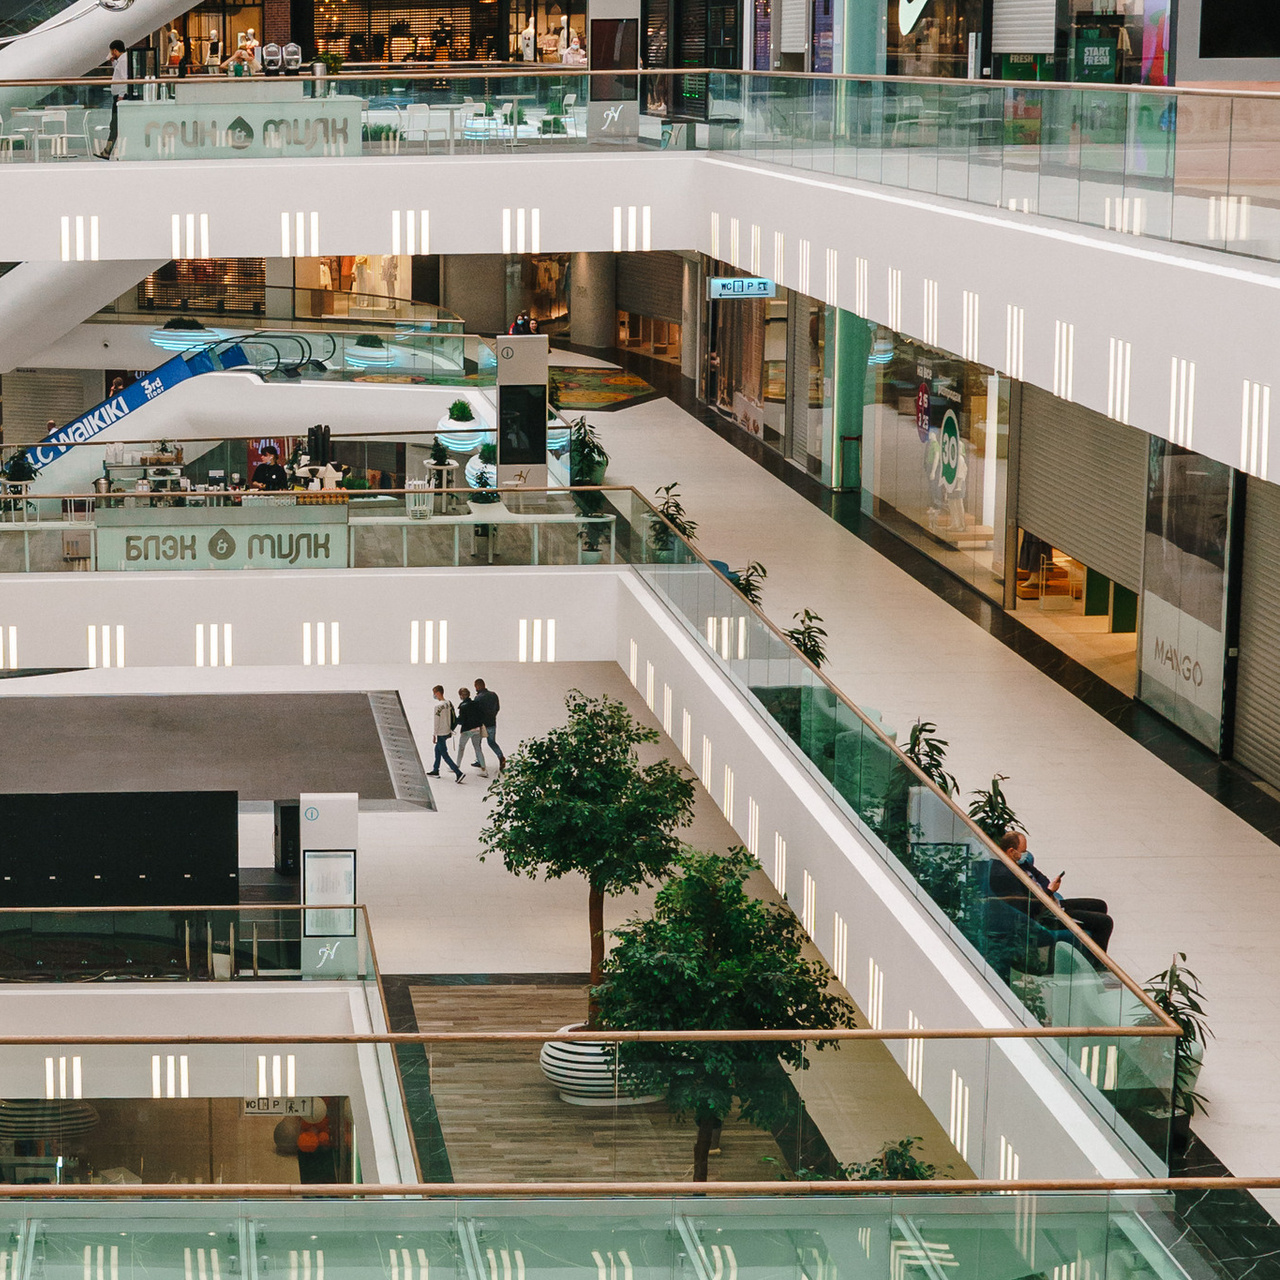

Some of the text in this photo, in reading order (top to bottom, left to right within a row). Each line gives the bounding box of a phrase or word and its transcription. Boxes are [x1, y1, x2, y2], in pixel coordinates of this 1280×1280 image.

[1084, 47, 1110, 57] START
[1010, 54, 1034, 64] FRESH
[1084, 55, 1110, 65] FRESH
[721, 282, 754, 291] WC P
[140, 376, 163, 394] 3rd
[147, 386, 164, 400] floor
[942, 432, 958, 469] 30
[1154, 636, 1203, 687] MANGO
[272, 1100, 280, 1109] P
